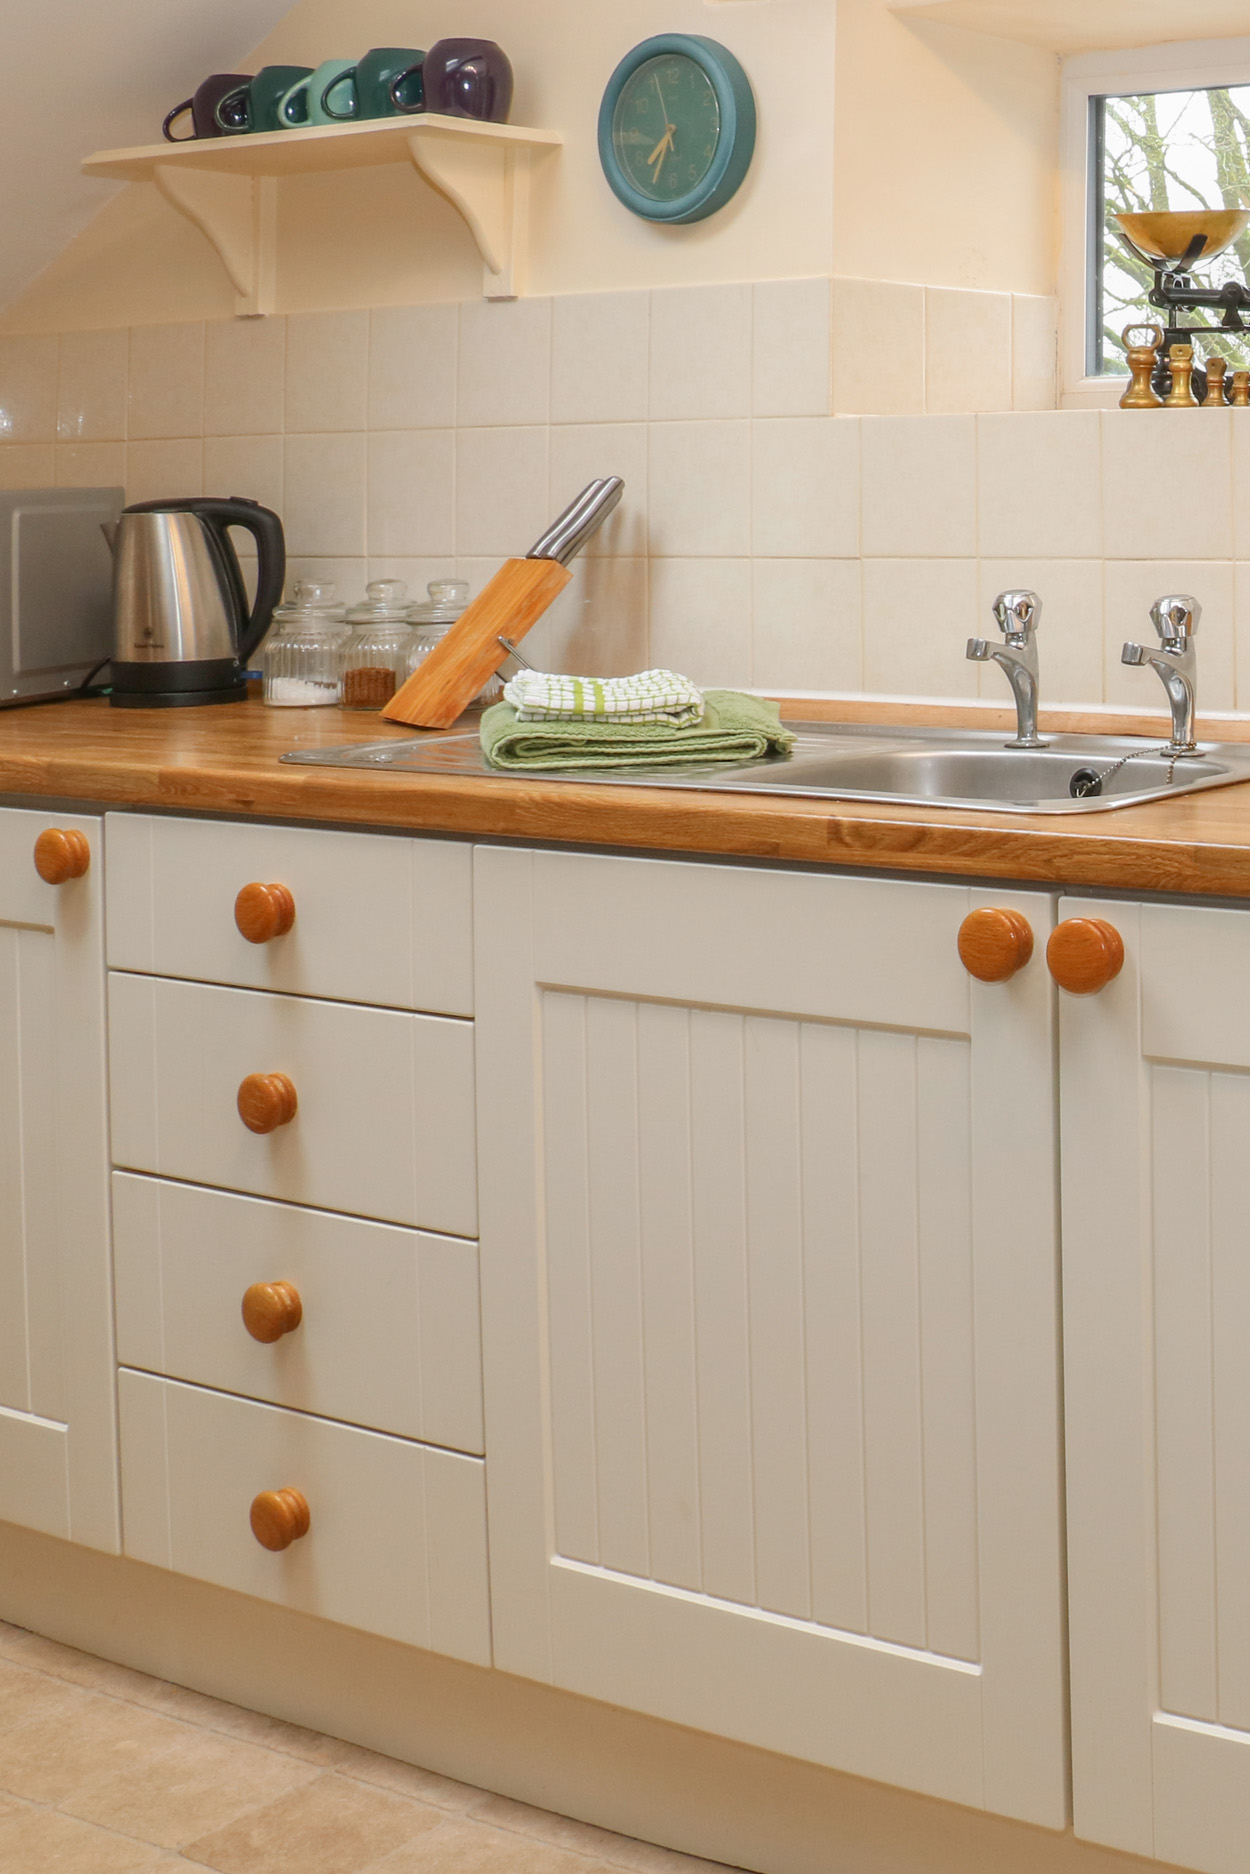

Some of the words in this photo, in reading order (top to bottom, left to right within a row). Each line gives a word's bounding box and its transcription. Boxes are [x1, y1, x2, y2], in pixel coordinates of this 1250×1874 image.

[666, 67, 679, 84] 12
[636, 98, 648, 113] 10
[703, 91, 712, 106] 2
